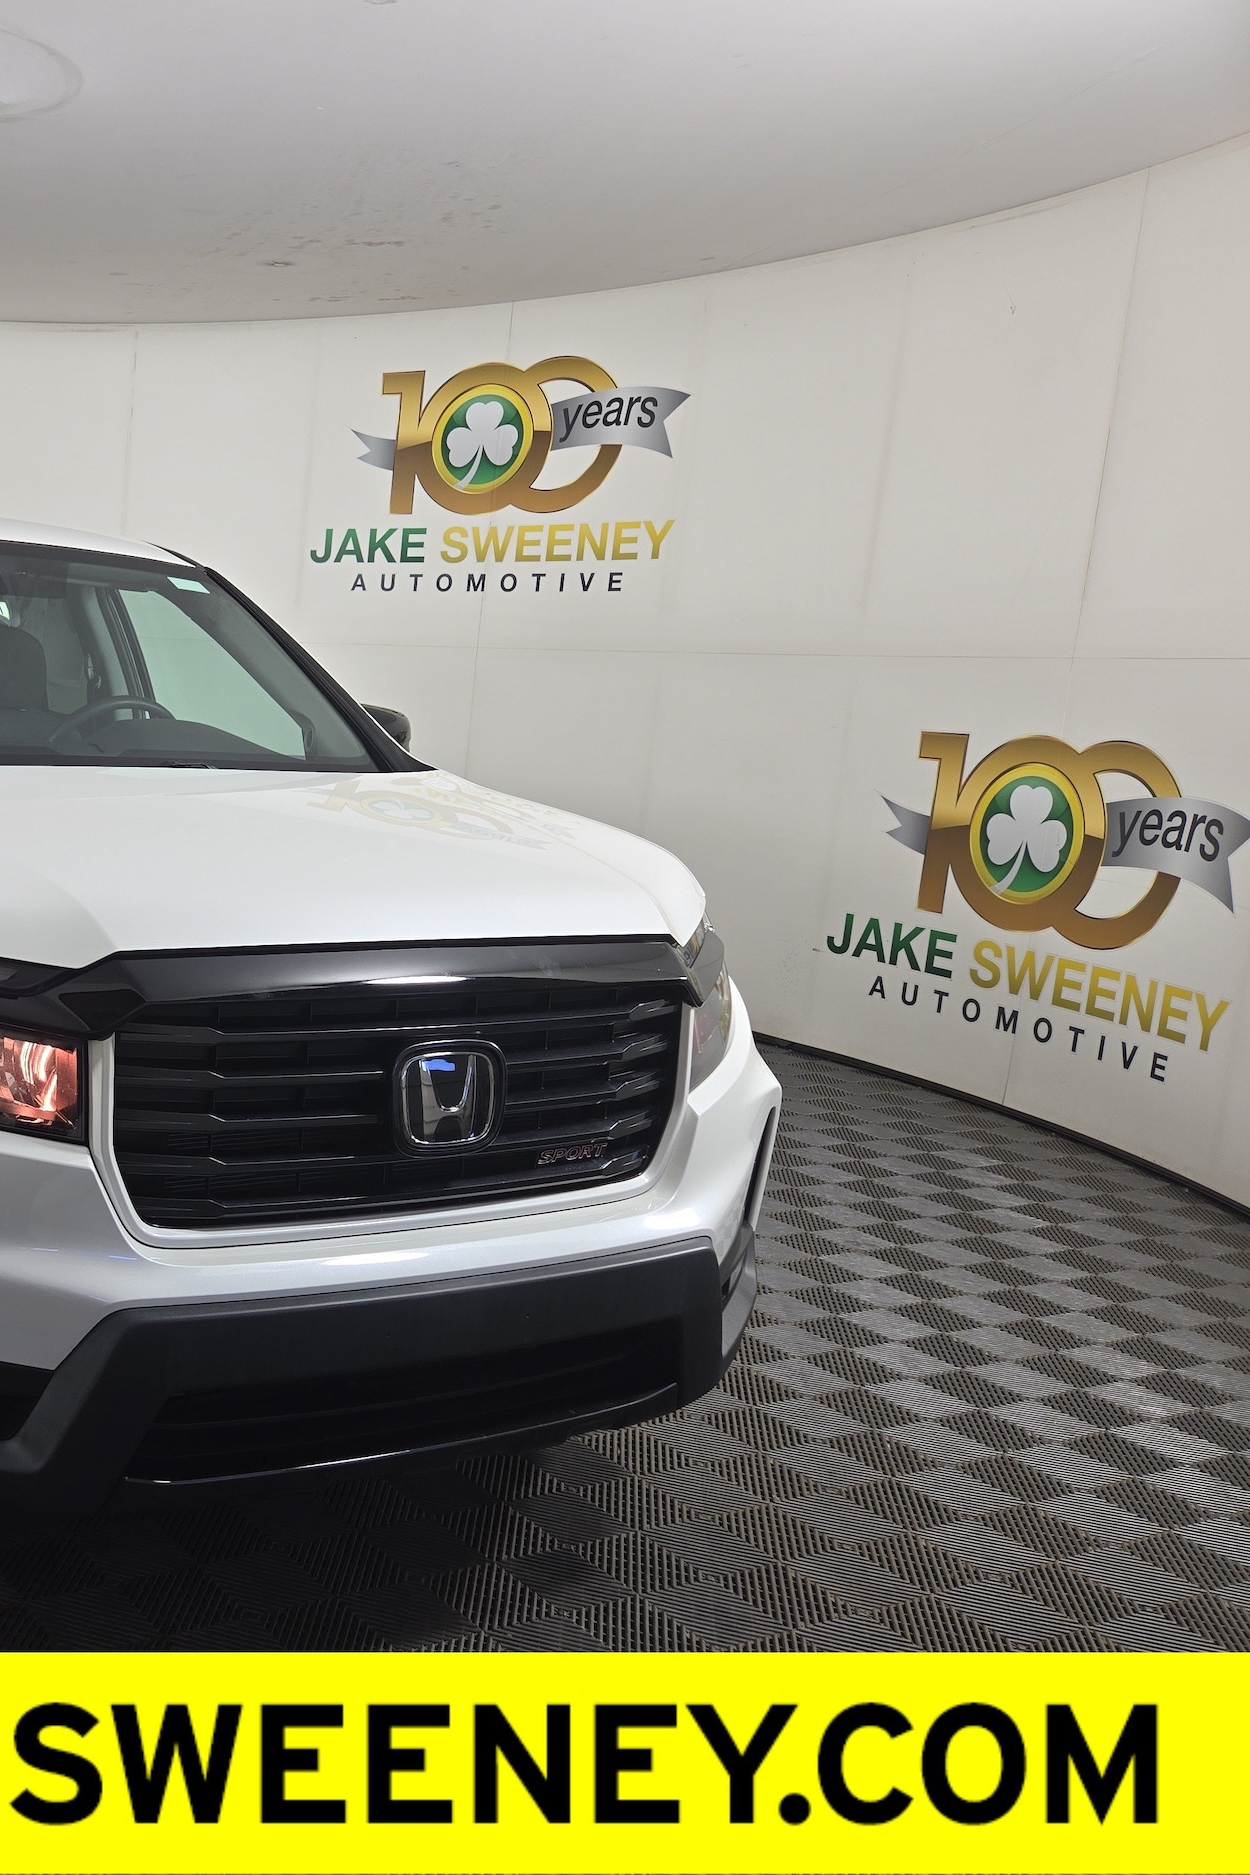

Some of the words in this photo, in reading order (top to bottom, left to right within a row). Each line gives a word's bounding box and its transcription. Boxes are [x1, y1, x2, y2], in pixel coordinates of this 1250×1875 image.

[382, 356, 623, 515] 100
[559, 396, 658, 442] years
[310, 527, 428, 563] JAKE
[440, 520, 676, 563] SWEENEY
[351, 572, 623, 592] AUTOMOTIVE
[916, 731, 1182, 950] 100
[1111, 808, 1224, 862] years
[826, 913, 958, 979] JAKE
[969, 940, 1230, 1052] SWEENEY
[868, 976, 1168, 1082] AUTOMOTIVE
[538, 1142, 608, 1165] SPORT
